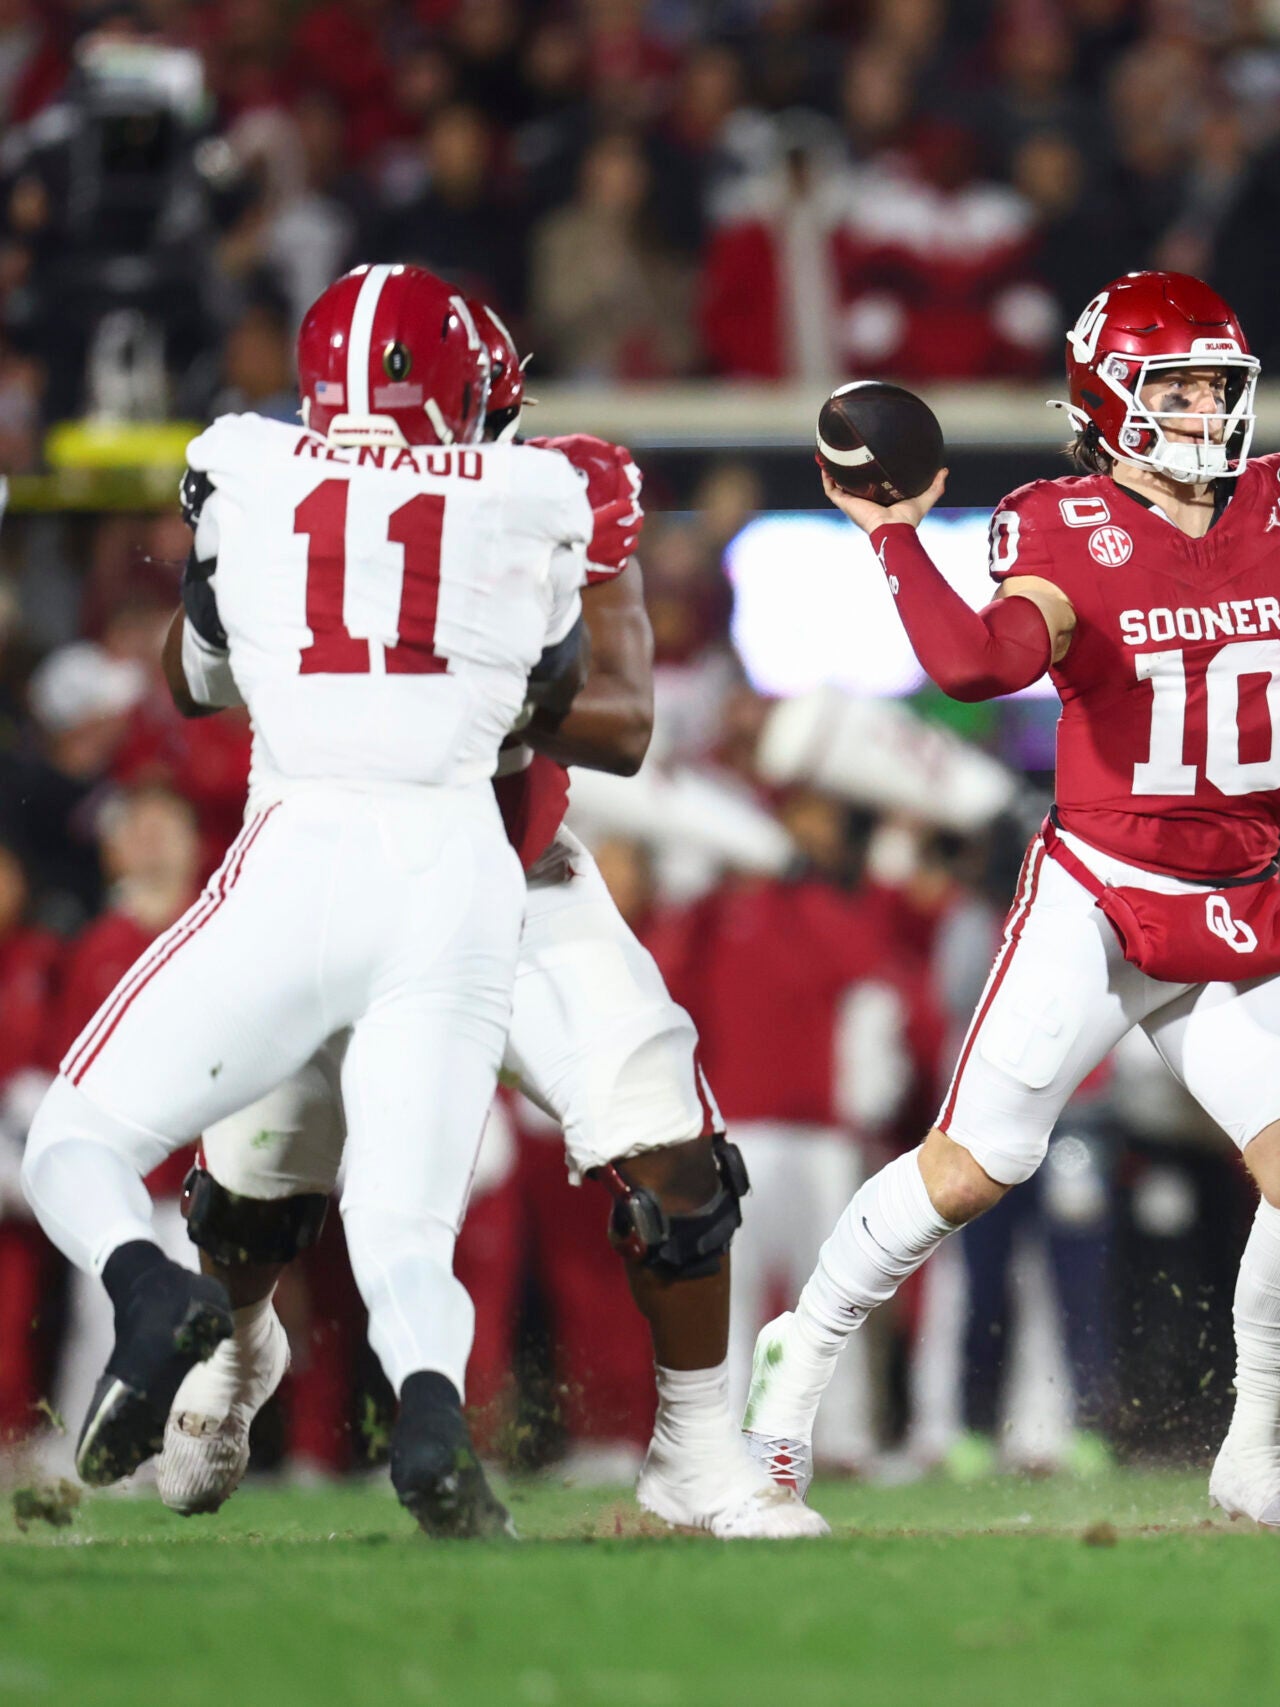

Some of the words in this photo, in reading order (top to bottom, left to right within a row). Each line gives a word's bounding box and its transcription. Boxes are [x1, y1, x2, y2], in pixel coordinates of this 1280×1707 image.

[294, 435, 482, 480] RENAUD
[1061, 499, 1106, 525] C
[1091, 528, 1129, 565] SEC
[294, 479, 452, 674] 11
[1205, 894, 1258, 954] OU
